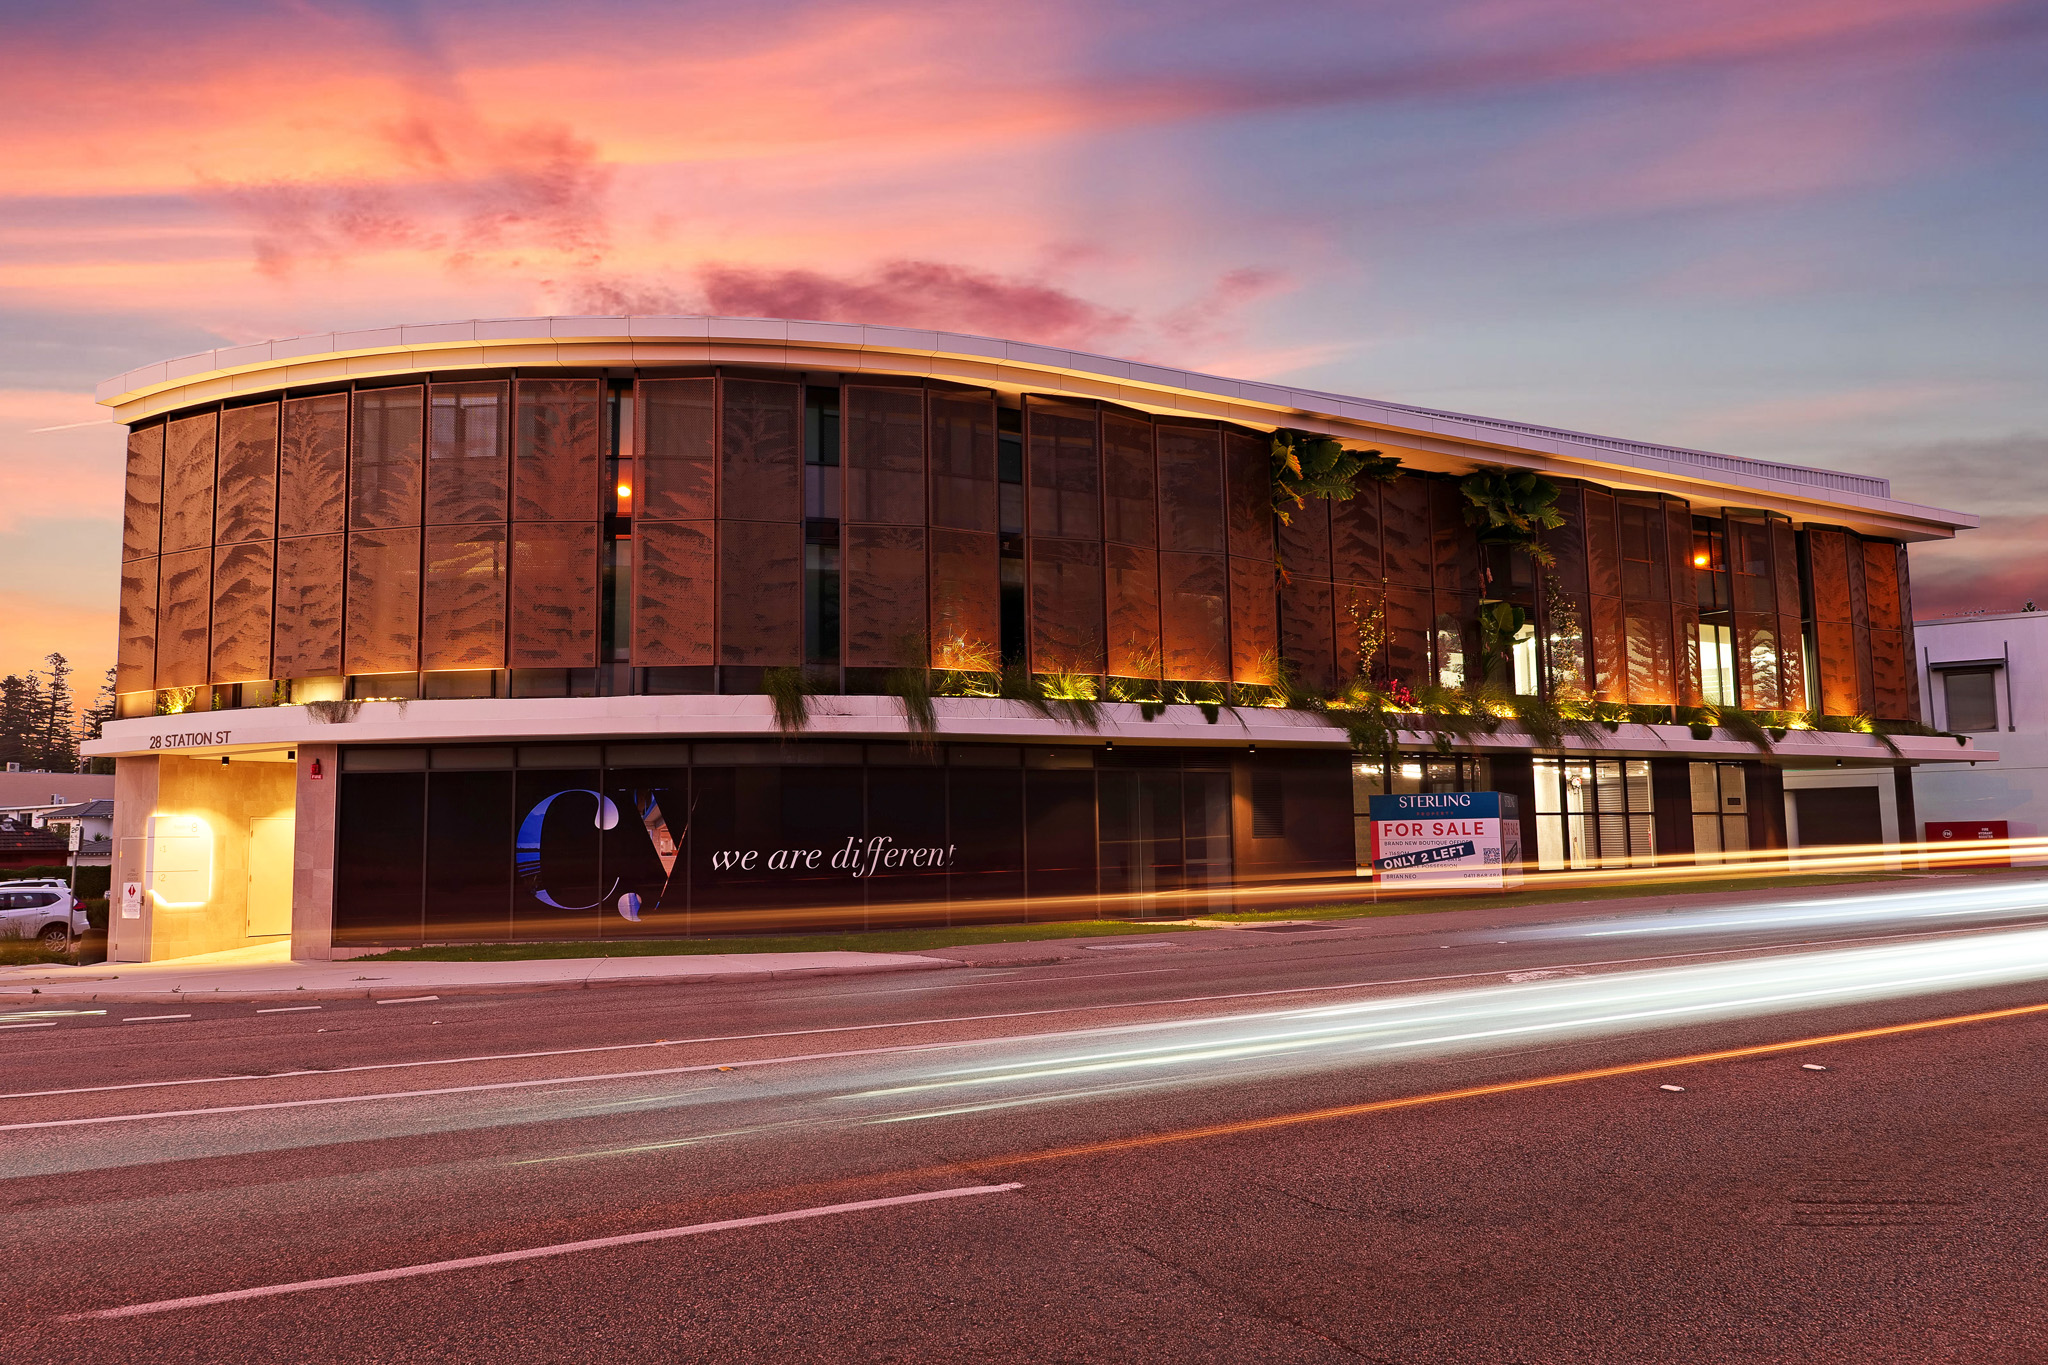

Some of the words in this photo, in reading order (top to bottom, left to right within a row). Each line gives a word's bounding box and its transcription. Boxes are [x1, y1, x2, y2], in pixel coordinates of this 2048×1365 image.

[149, 735, 162, 749] 28
[164, 731, 213, 748] STATION
[215, 730, 232, 744] ST
[1399, 794, 1471, 809] STERLING
[1384, 823, 1423, 837] FOR
[1432, 822, 1484, 836] SALE
[712, 850, 758, 870] we
[768, 849, 822, 870] are
[831, 836, 957, 877] different
[1383, 855, 1417, 870] ONLY
[1421, 852, 1430, 863] 2
[1432, 845, 1465, 860] LEFT
